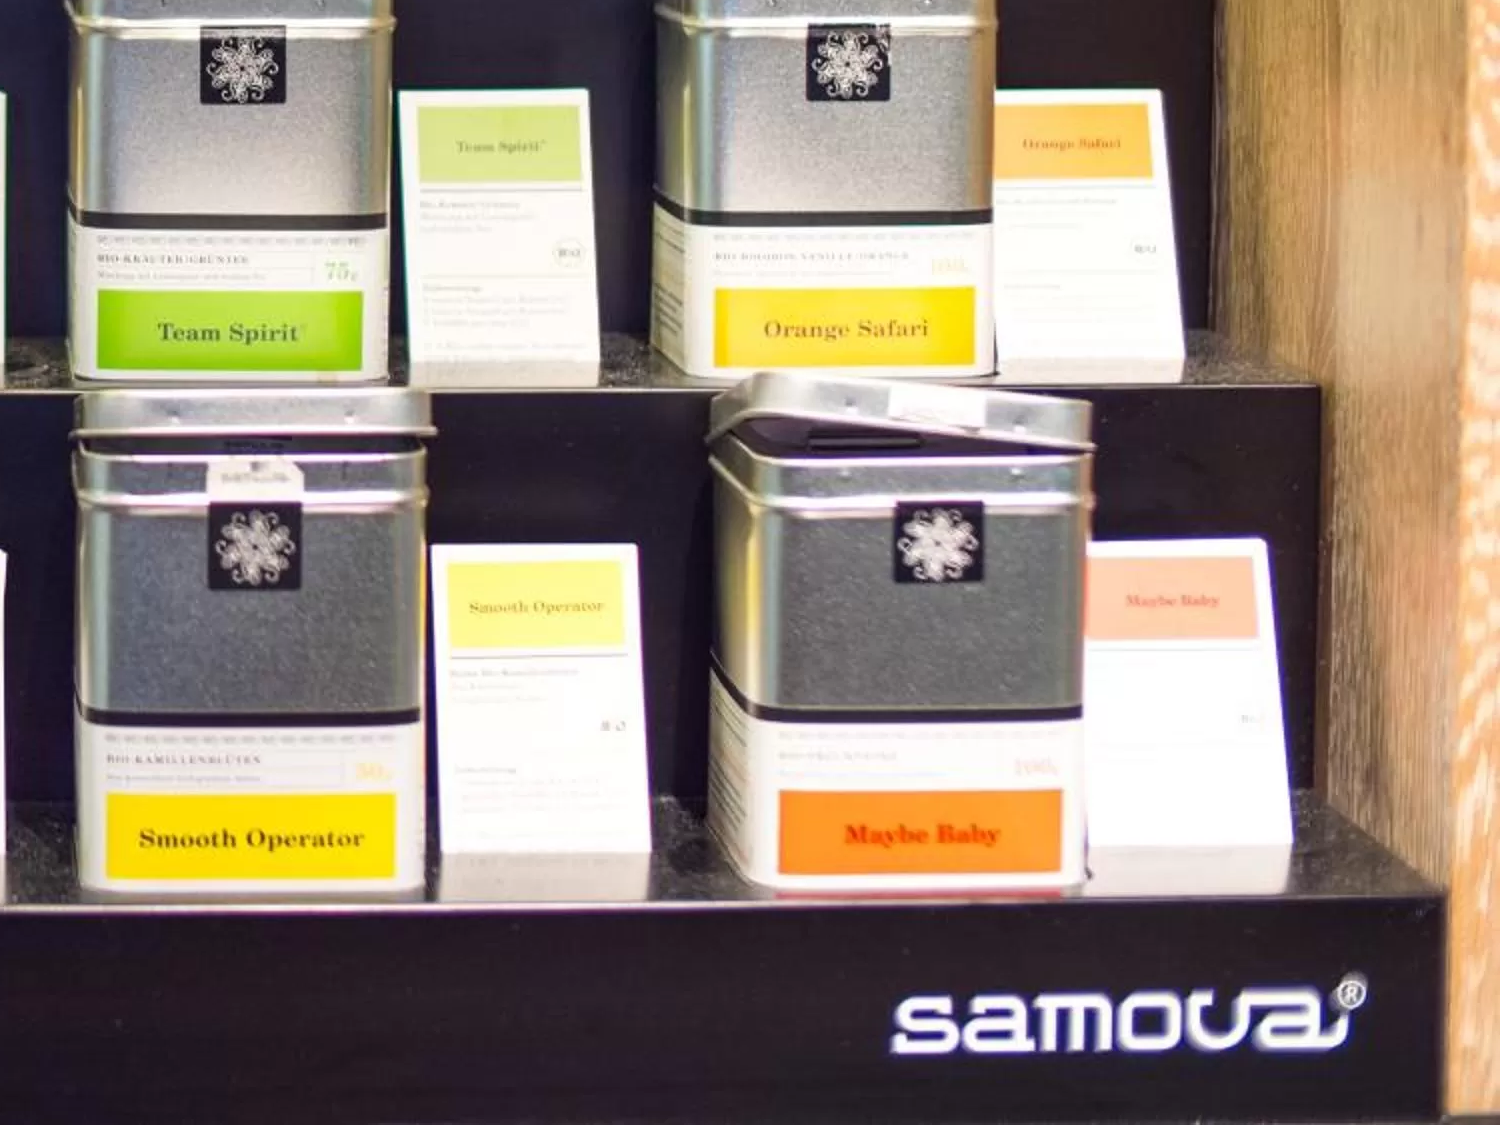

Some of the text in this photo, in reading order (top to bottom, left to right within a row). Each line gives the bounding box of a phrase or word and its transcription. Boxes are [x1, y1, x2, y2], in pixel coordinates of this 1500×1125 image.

[456, 140, 495, 153] Team
[1022, 138, 1122, 152] Orange Safari
[157, 322, 299, 346] Team Spirit
[763, 319, 930, 341] Orange Safari
[469, 600, 606, 616] Smooth Operator
[1125, 594, 1221, 609] Maybe Baby
[138, 827, 366, 852] Smooth Operator
[843, 824, 1002, 848] Maybe Baby
